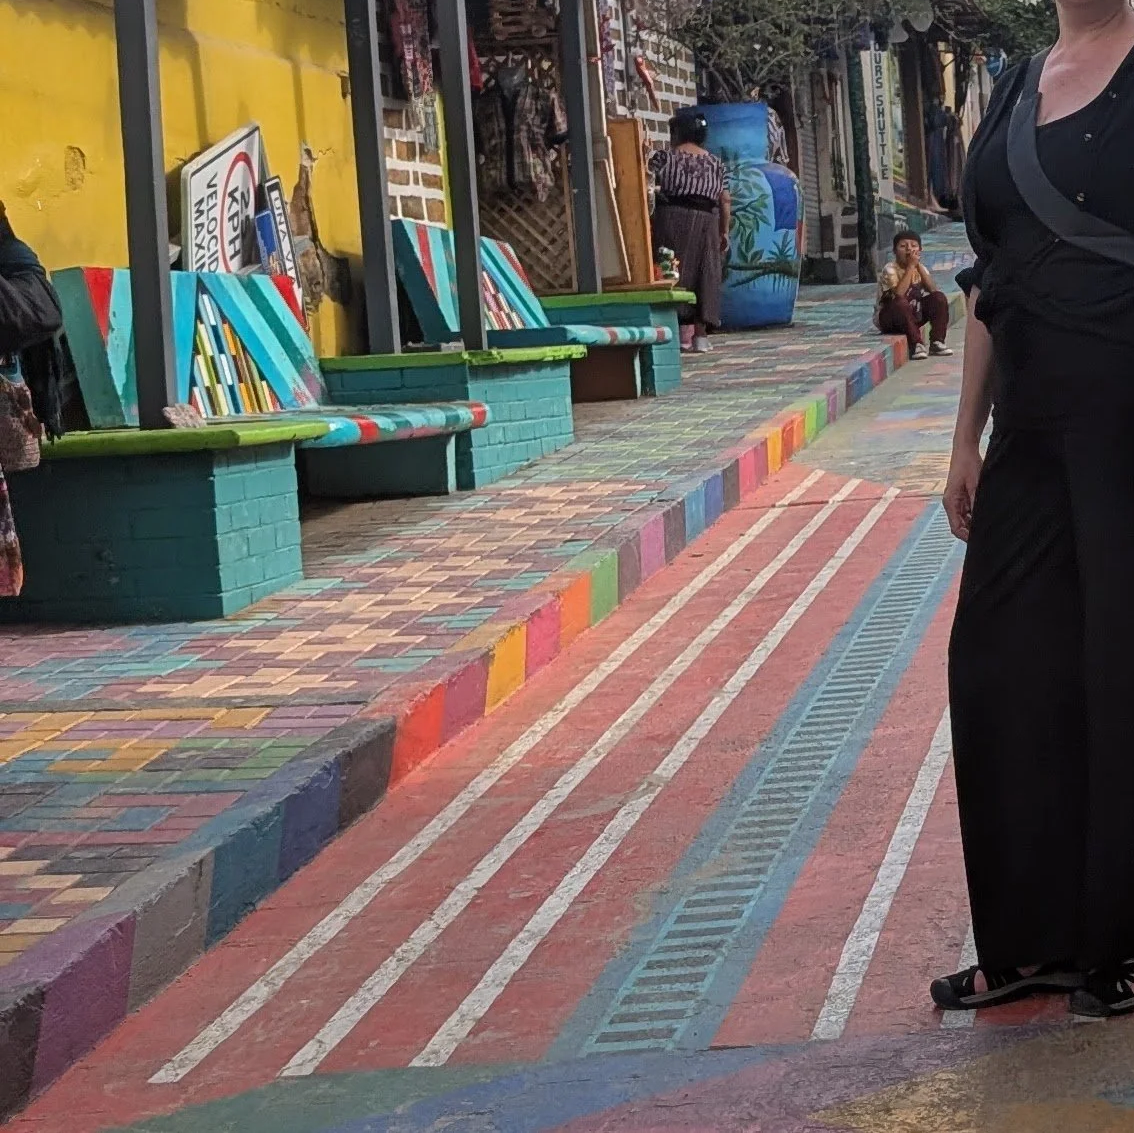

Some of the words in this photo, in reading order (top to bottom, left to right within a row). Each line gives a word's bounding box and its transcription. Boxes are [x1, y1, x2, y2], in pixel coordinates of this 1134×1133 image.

[876, 95, 889, 180] SHUTTLE
[228, 186, 241, 261] KPH
[274, 197, 287, 241] UNA
